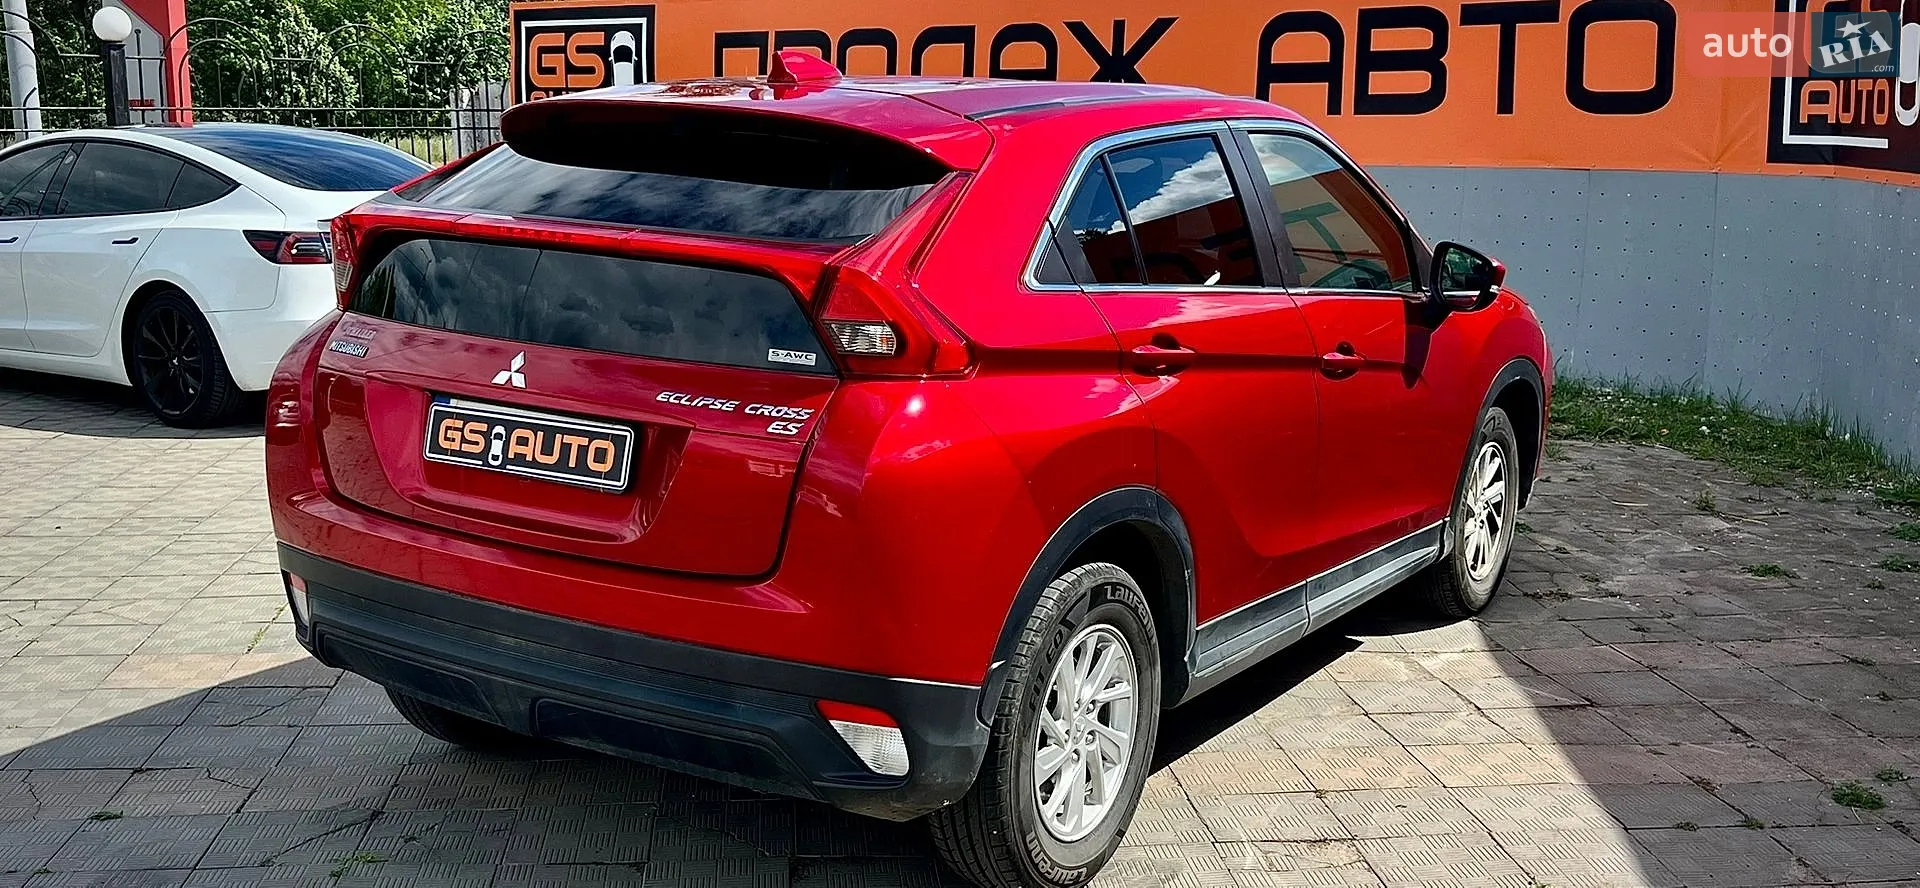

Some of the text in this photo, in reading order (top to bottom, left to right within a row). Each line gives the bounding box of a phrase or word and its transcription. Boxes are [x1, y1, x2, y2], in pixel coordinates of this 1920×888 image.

[529, 31, 605, 88] GS
[1255, 0, 1678, 117] АВТО
[1799, 78, 1890, 125] AUTO
[771, 350, 814, 361] S-AWC
[655, 391, 815, 420] ECLIPSE CROSS
[766, 421, 805, 435] ES
[438, 418, 615, 473] GS AUTO
